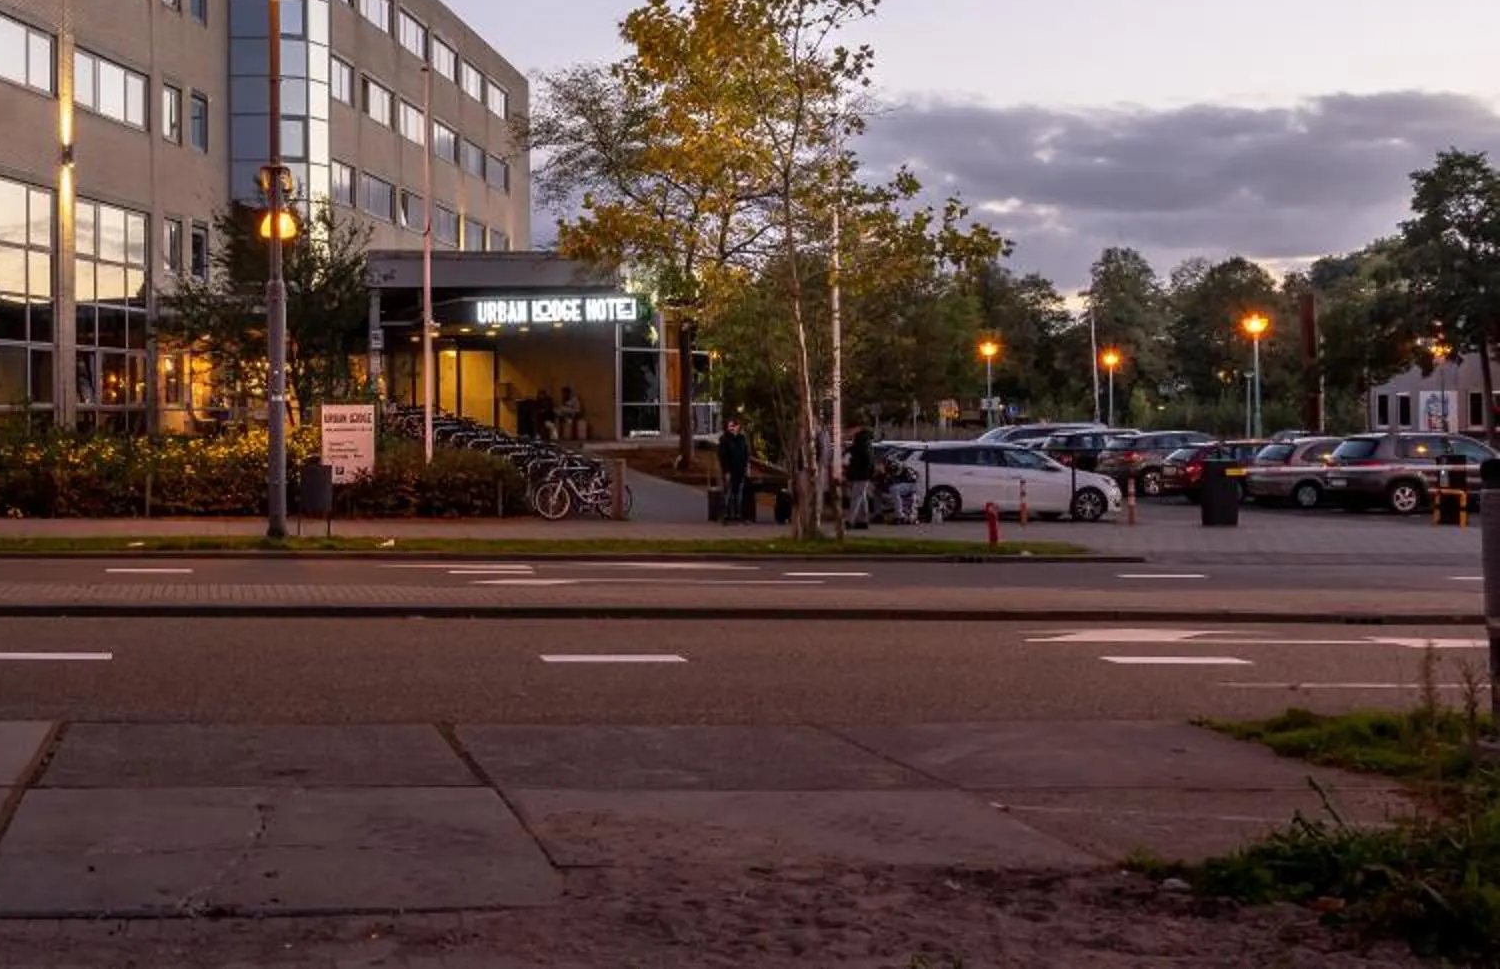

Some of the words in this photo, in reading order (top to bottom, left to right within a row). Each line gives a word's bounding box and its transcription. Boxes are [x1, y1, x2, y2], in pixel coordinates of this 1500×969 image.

[477, 300, 527, 324] URBAN
[531, 299, 582, 322] LODGE
[585, 298, 637, 321] HOTEL
